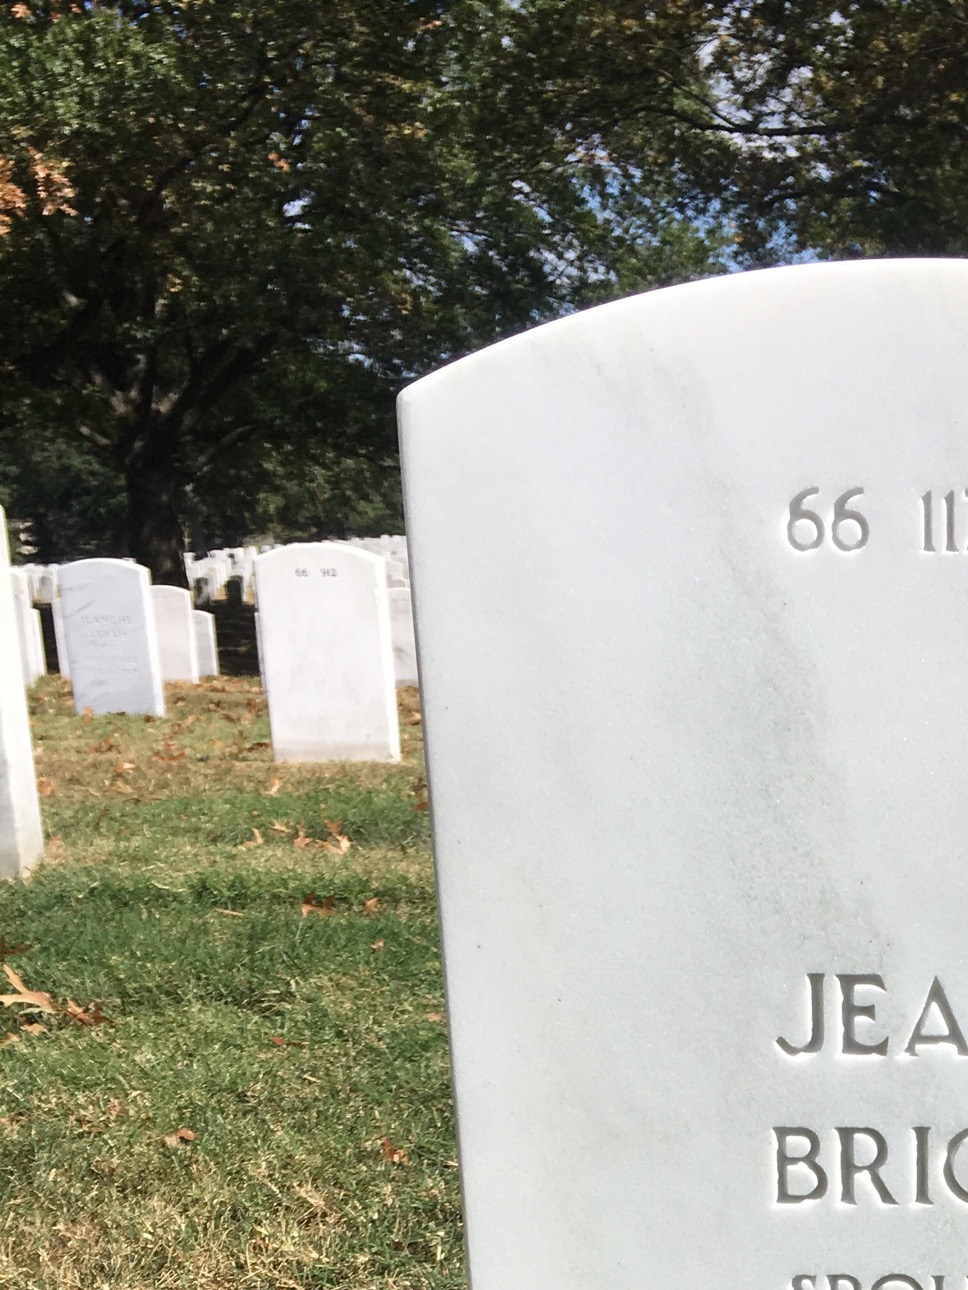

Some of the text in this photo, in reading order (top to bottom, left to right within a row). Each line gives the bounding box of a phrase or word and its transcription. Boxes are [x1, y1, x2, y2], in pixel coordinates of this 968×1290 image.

[786, 486, 870, 553] 66
[295, 567, 338, 578] 66 912
